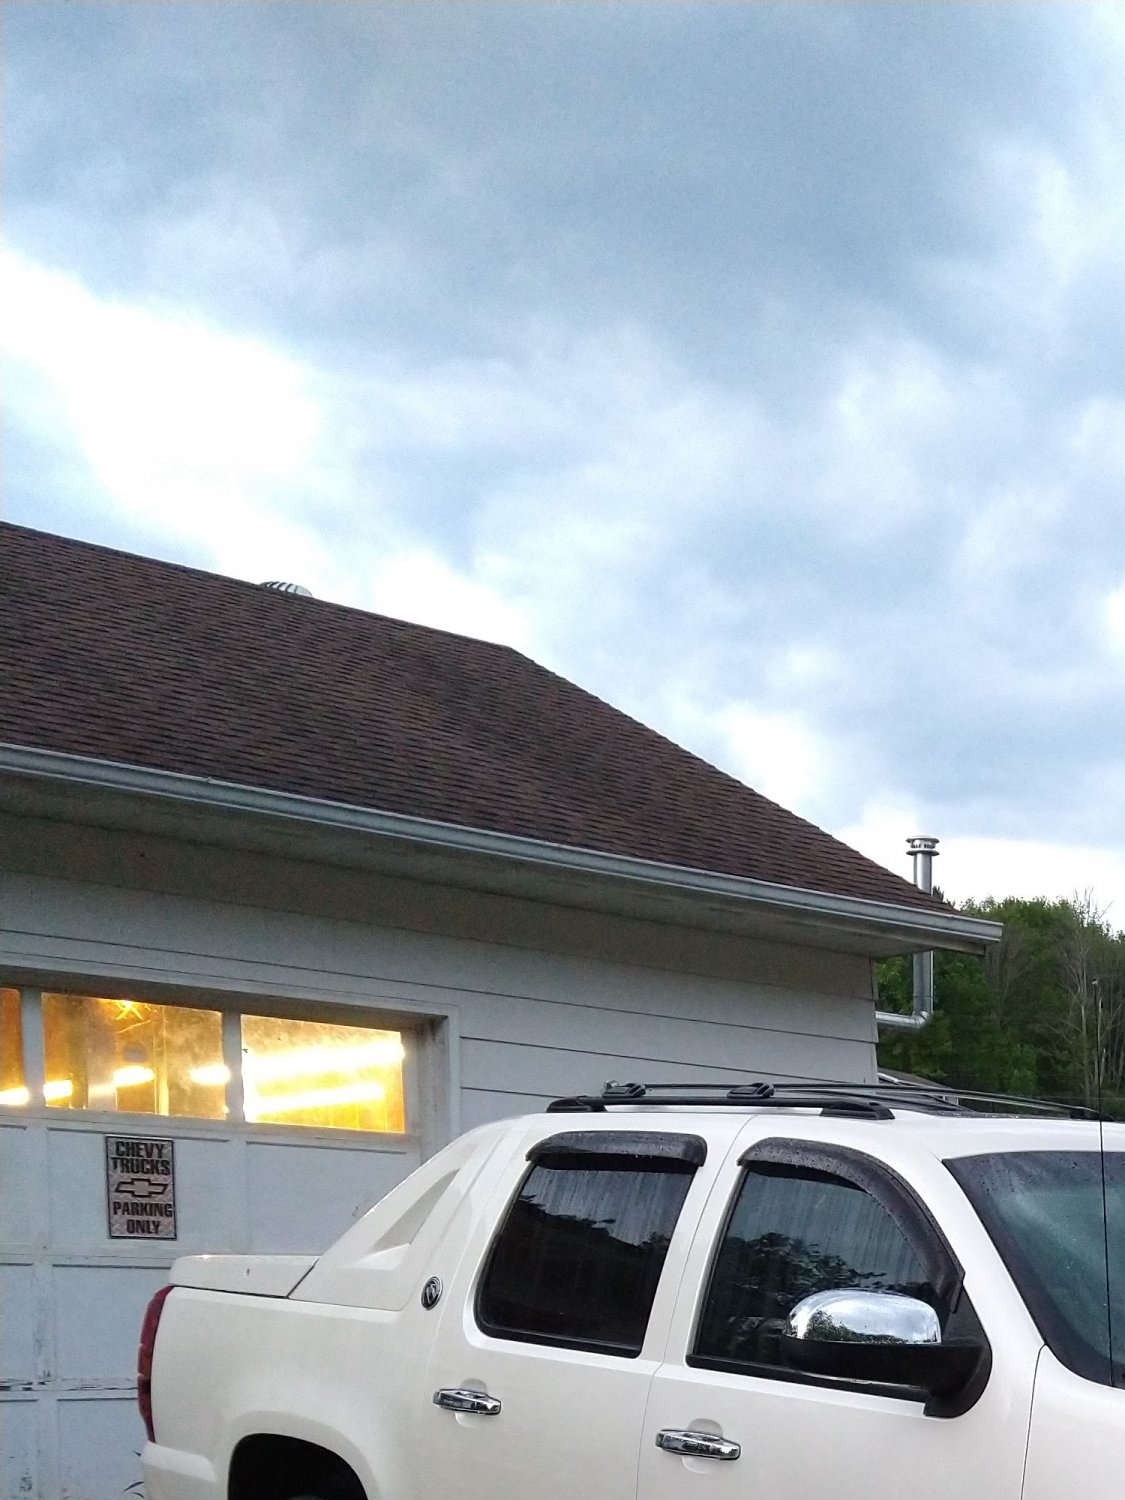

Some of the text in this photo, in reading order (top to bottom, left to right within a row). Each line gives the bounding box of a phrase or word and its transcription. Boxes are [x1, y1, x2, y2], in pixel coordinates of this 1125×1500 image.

[116, 1140, 164, 1159] CHEVY
[110, 1156, 171, 1175] TRUCKS
[113, 1201, 173, 1217] PARKING
[126, 1219, 160, 1234] ONLY
